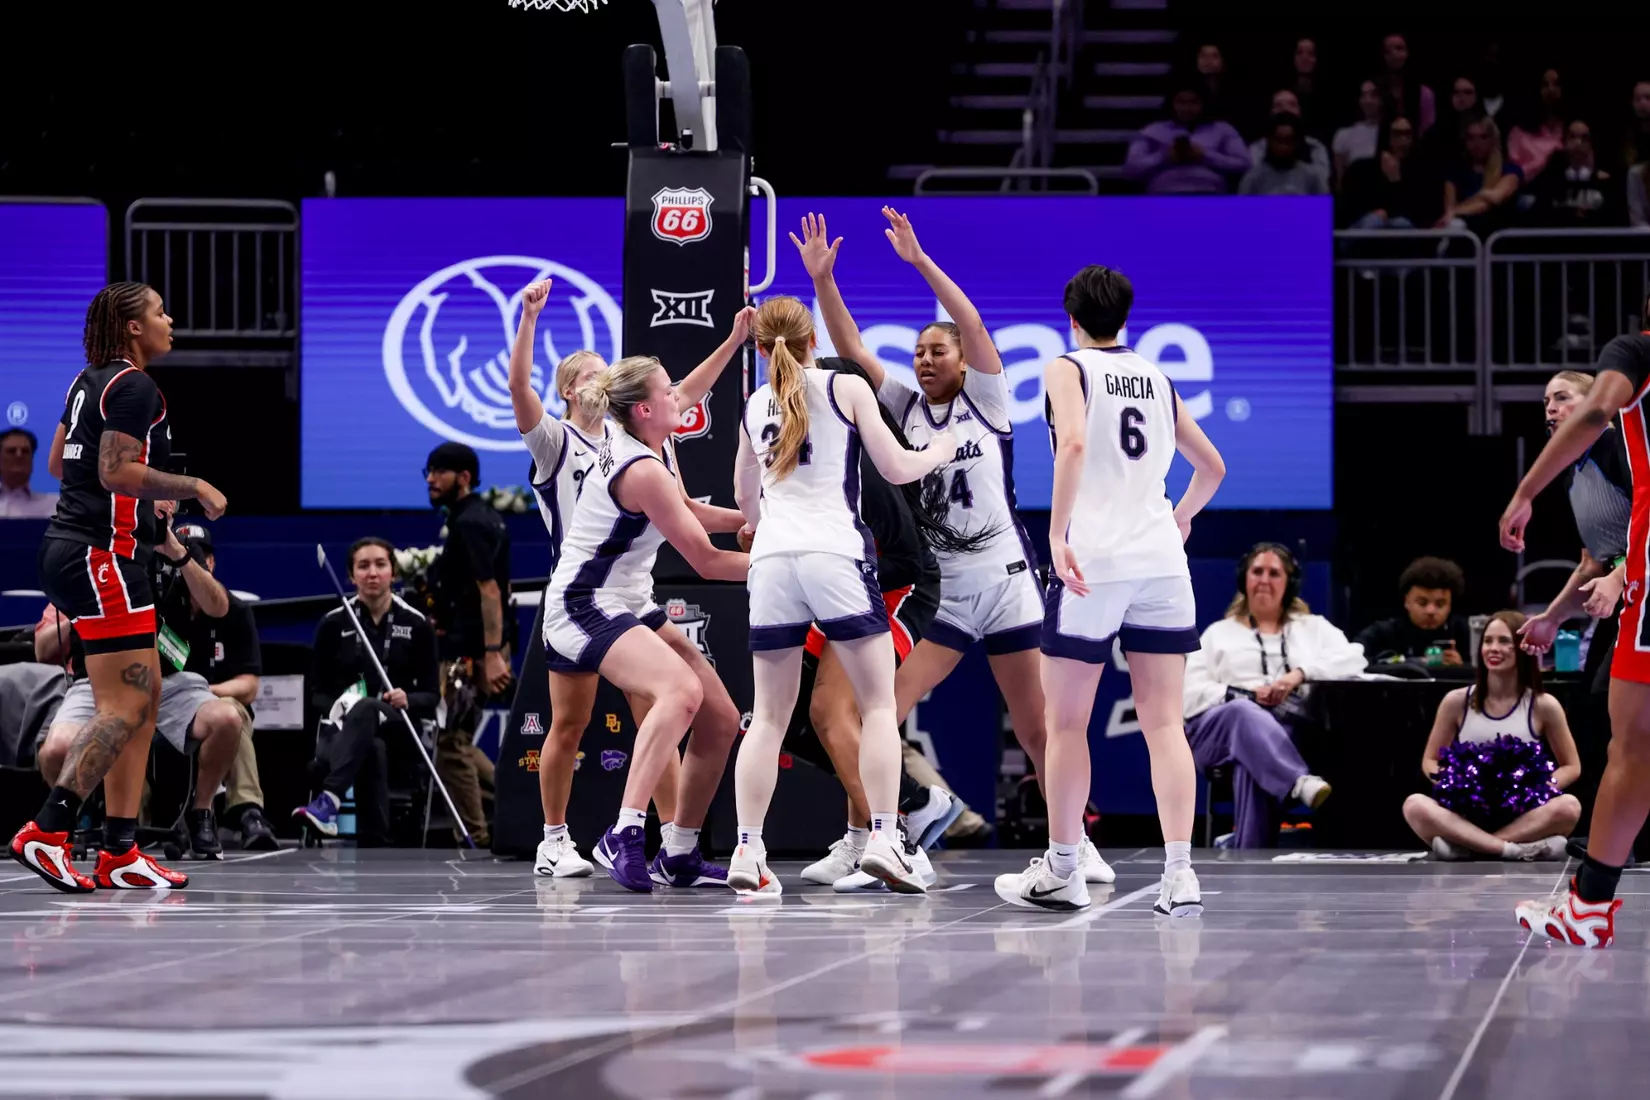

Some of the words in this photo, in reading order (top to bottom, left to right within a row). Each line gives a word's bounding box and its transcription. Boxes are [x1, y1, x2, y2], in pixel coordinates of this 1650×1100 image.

[661, 196, 704, 206] PHILLIPS
[662, 209, 701, 232] 66
[1105, 373, 1155, 400] GARCIA
[65, 389, 85, 440] 9
[680, 405, 699, 428] 6
[1120, 406, 1147, 460] 6
